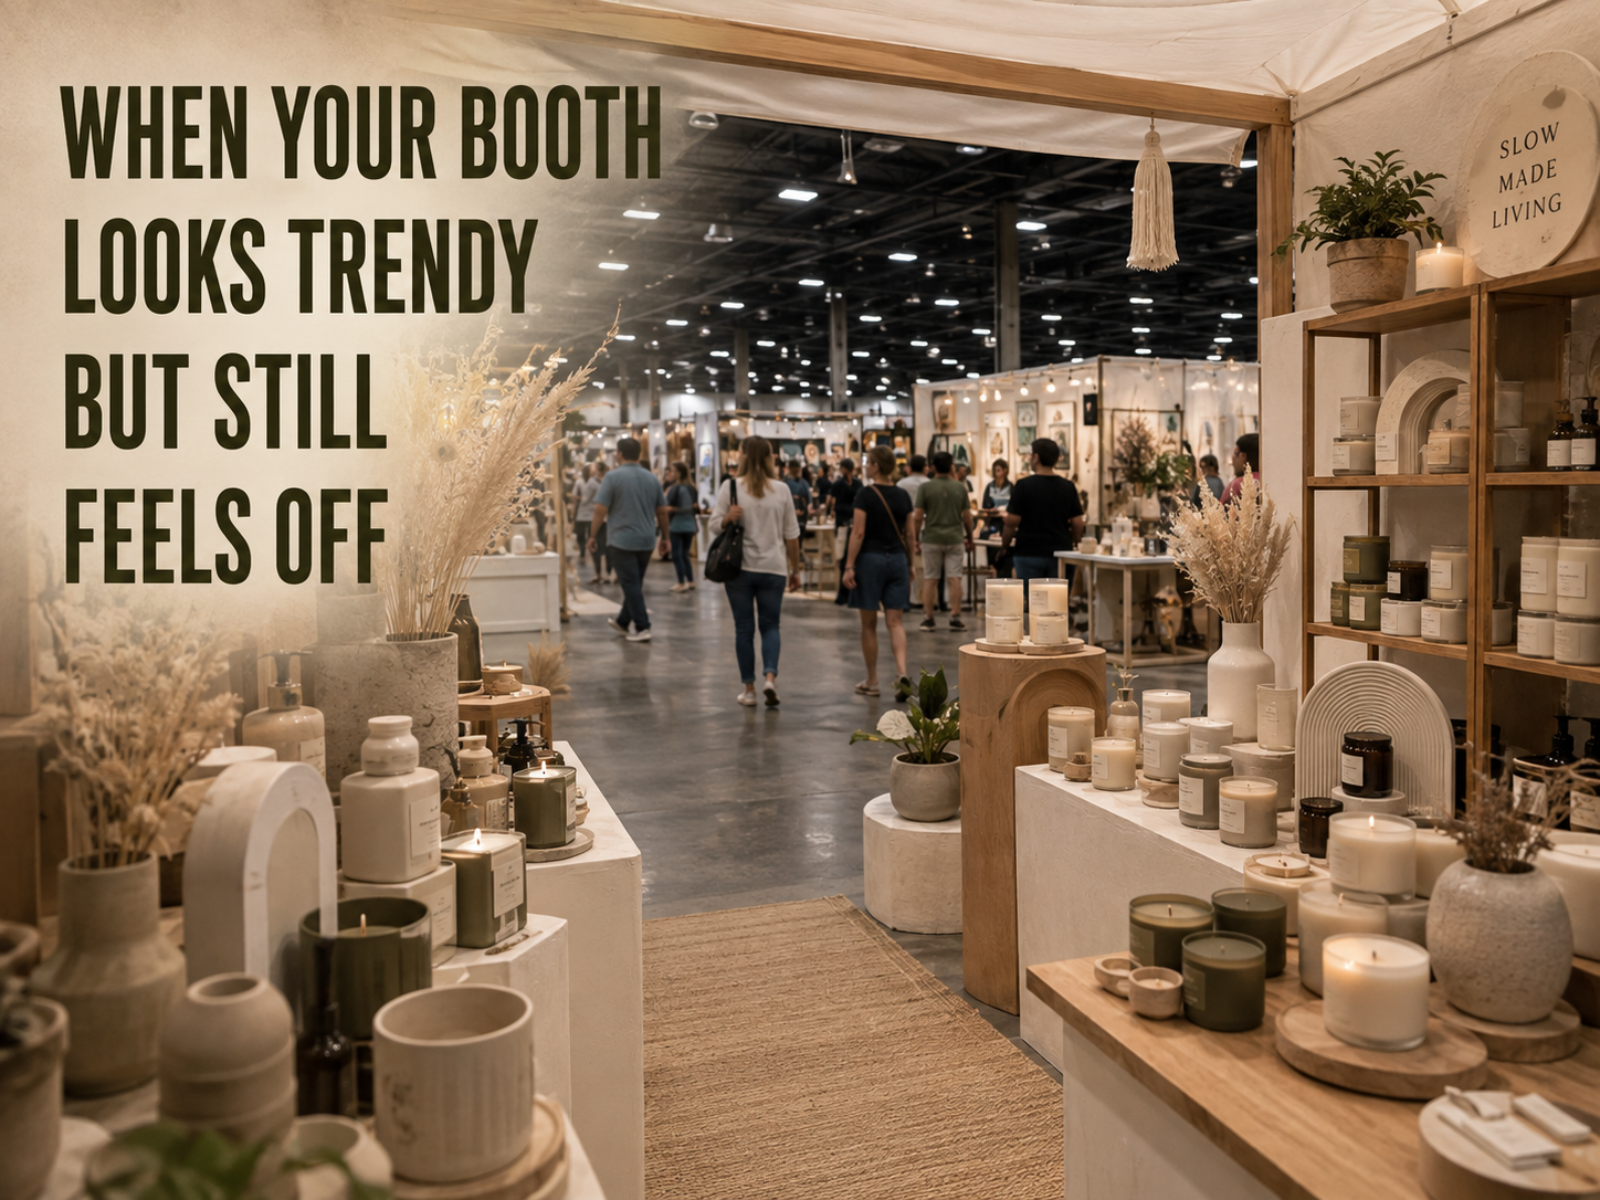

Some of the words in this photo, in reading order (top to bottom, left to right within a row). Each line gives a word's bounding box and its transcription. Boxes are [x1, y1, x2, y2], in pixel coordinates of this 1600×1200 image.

[1500, 121, 1560, 159] SLOW
[1499, 158, 1557, 193] MADE
[1492, 192, 1562, 229] LIVING
